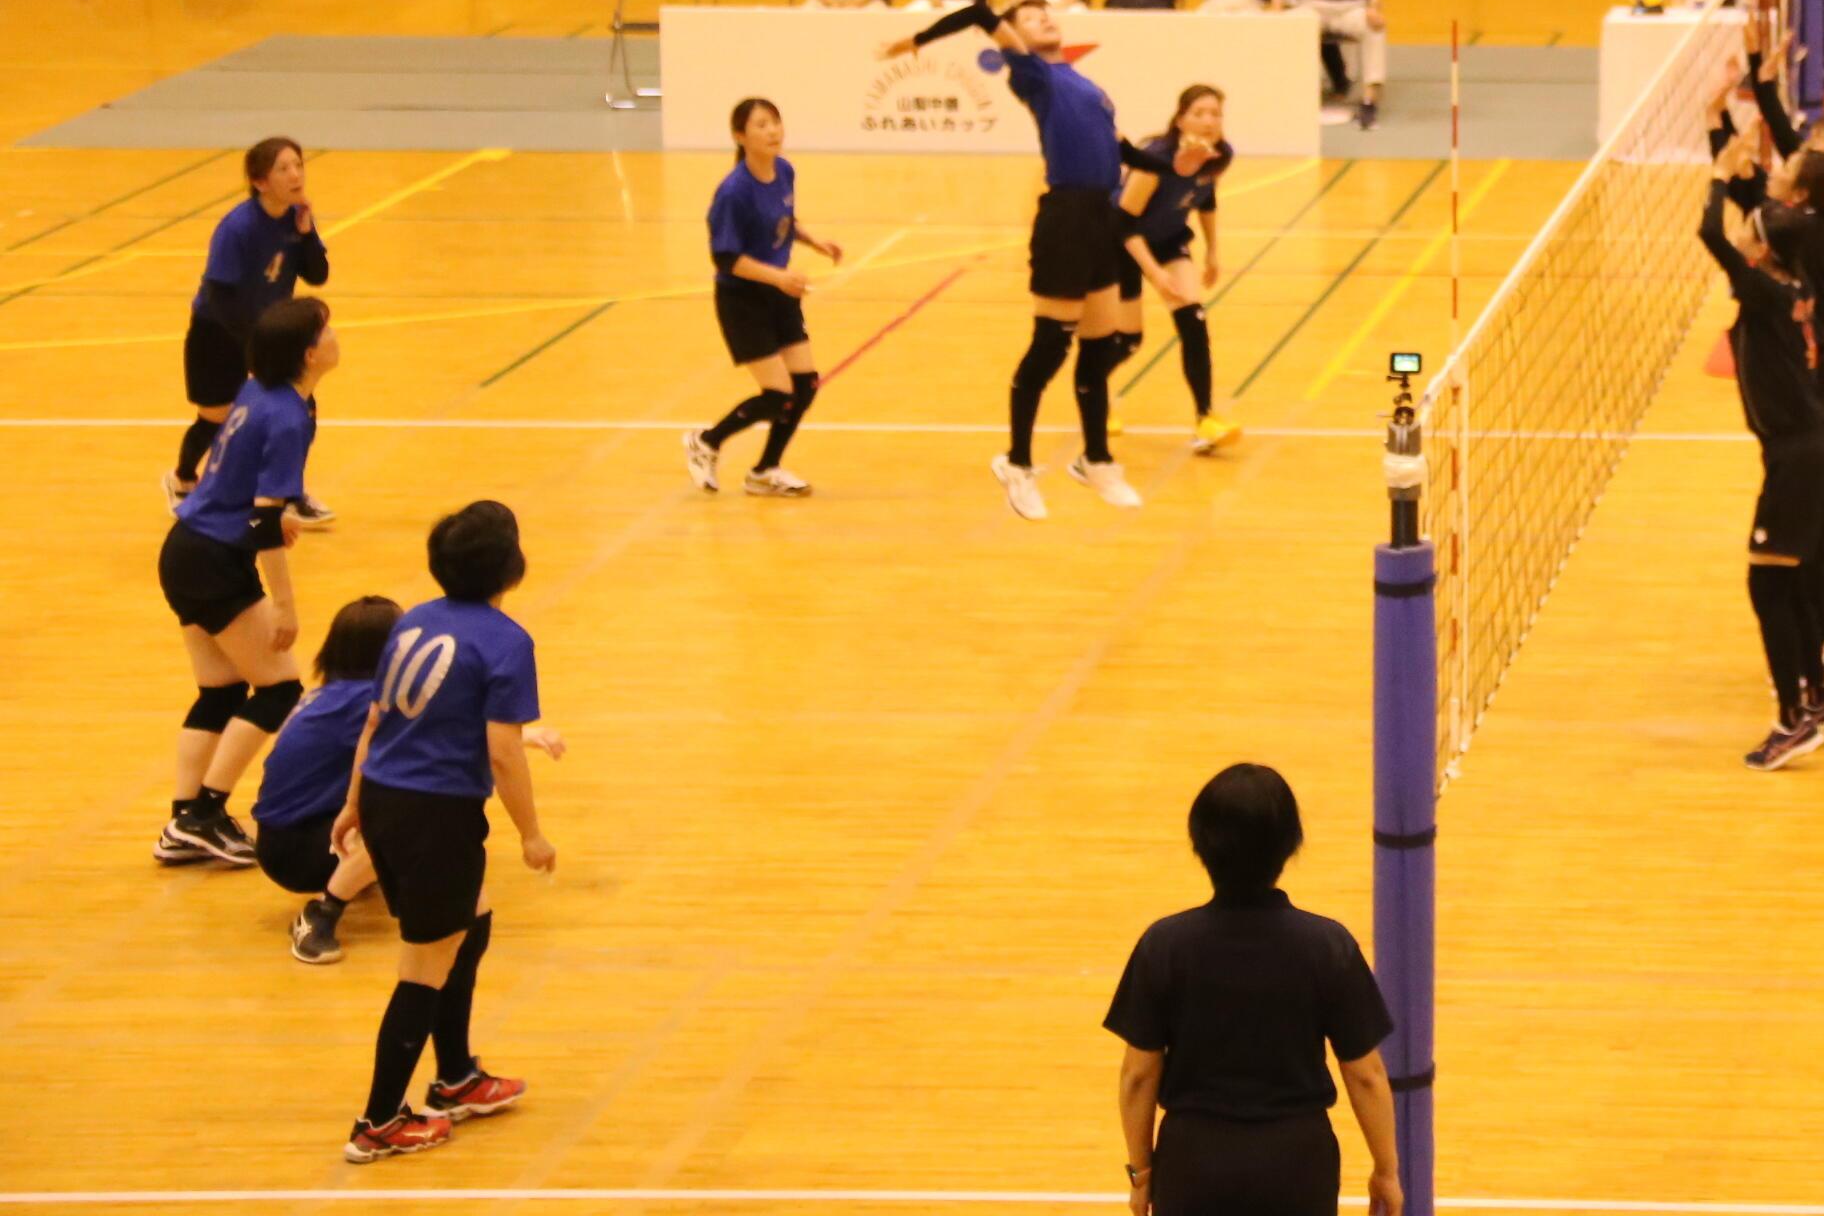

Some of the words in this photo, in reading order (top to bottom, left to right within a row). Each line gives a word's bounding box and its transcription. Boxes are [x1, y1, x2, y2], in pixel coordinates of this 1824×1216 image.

[861, 116, 999, 132] ふれあいカップ
[264, 250, 284, 283] 4
[379, 626, 456, 720] 10
